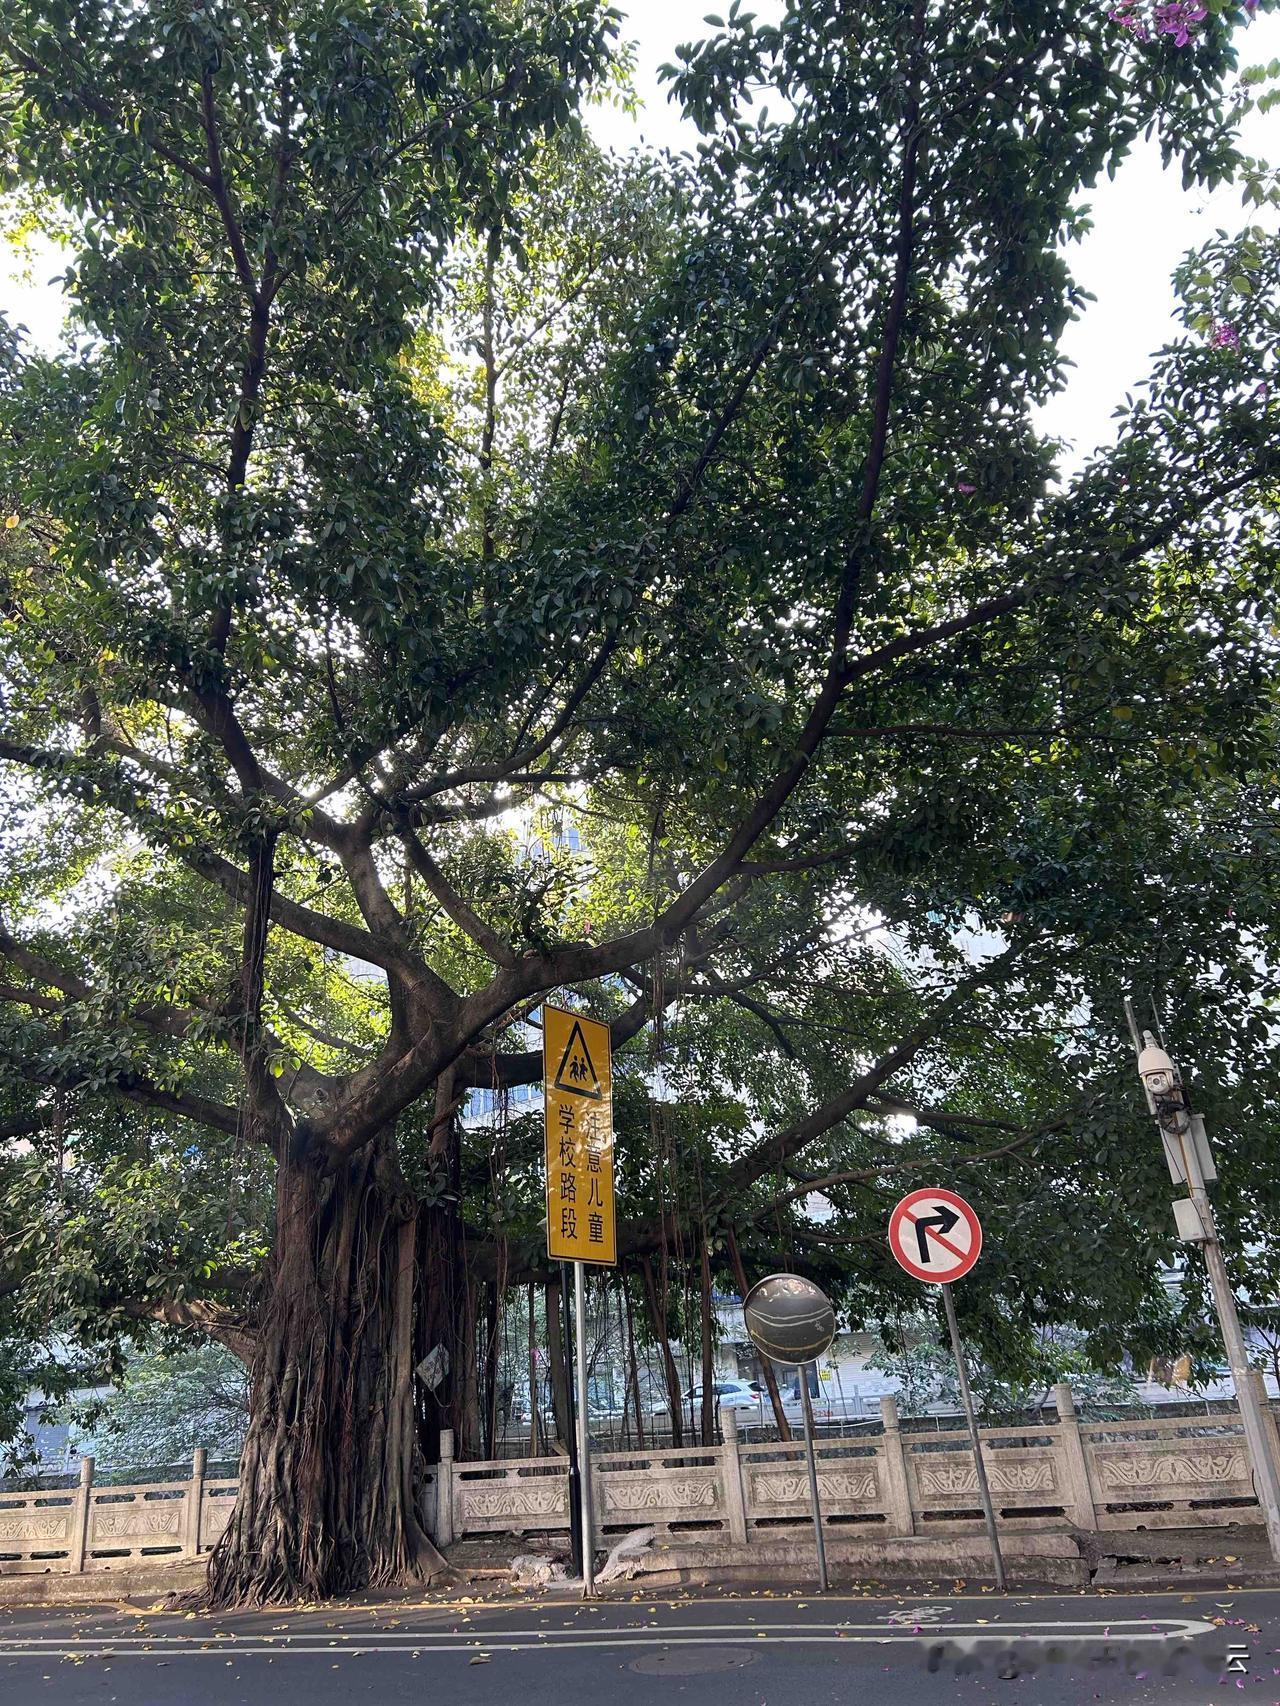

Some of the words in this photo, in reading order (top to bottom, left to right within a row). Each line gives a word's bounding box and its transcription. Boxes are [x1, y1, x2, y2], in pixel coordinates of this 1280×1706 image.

[558, 1104, 578, 1239] 学校路段
[585, 1111, 604, 1244] 注意儿童
